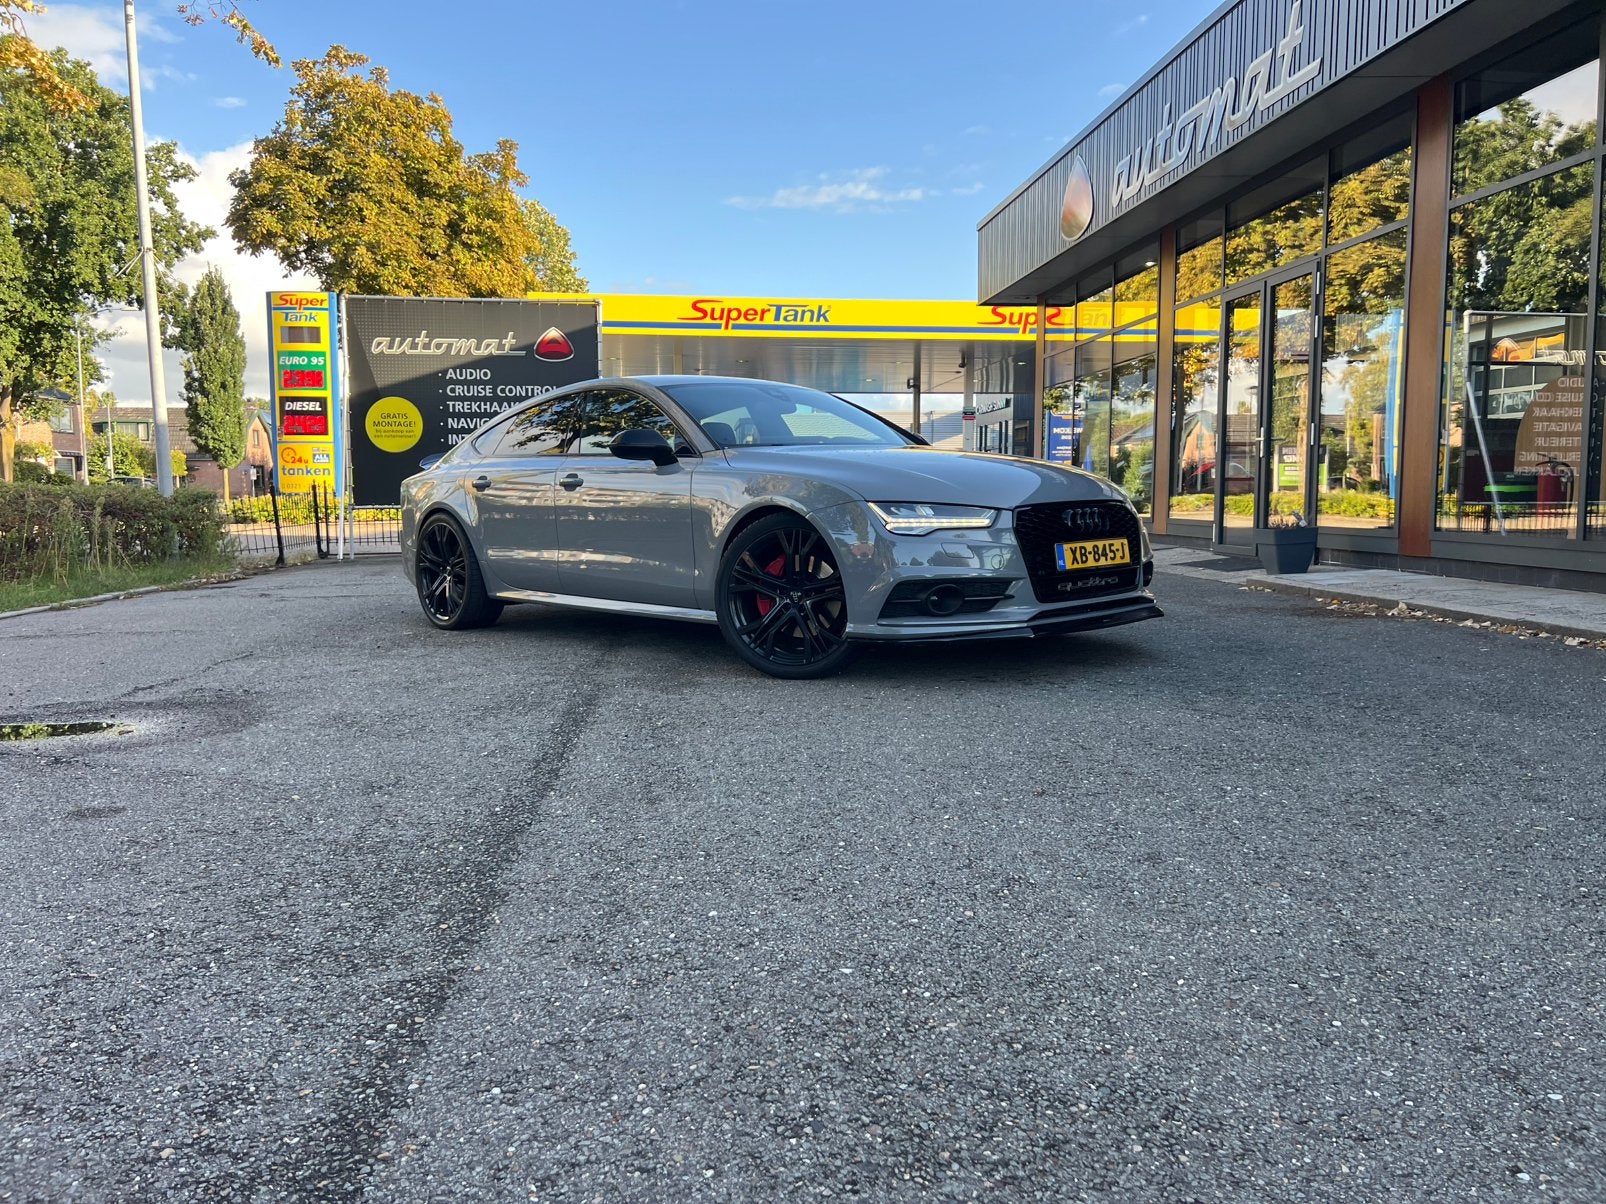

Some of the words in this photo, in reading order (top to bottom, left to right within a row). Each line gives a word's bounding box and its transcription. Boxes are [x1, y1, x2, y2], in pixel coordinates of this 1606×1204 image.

[1111, 0, 1322, 207] automat
[273, 294, 327, 311] Super
[280, 311, 318, 322] Tank
[371, 330, 527, 356] automat
[279, 356, 308, 365] EURO
[310, 356, 325, 365] 95
[446, 368, 491, 380] AUDIO
[446, 385, 493, 397] CRUISE
[285, 401, 322, 411] DIESEL
[381, 412, 408, 420] GRATIS
[373, 420, 416, 428] MONTAGE!
[291, 456, 303, 464] 24
[282, 465, 331, 476] tanken
[1069, 541, 1126, 566] XB-845-J
[1058, 576, 1119, 591] quattro
